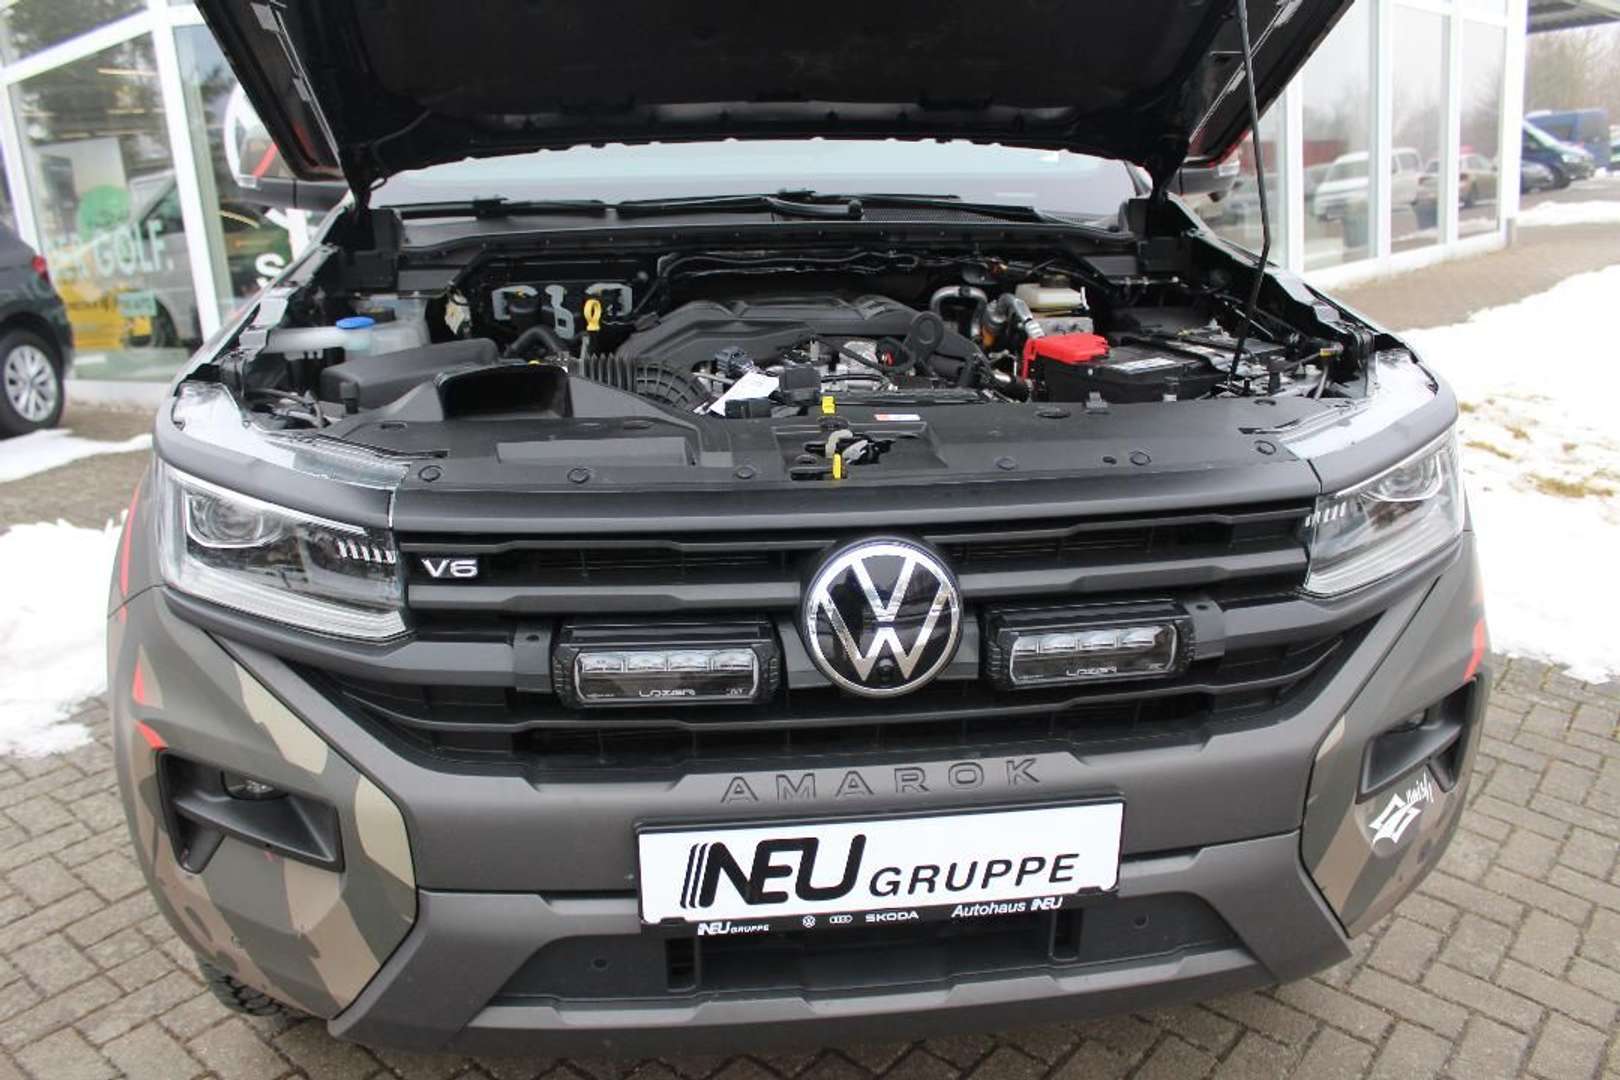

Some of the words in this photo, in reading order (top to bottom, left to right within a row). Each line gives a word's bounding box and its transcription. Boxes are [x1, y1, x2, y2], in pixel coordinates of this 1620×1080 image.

[421, 558, 478, 577] V6
[720, 757, 1041, 804] AMAROK
[680, 834, 867, 909] NEU
[868, 853, 1079, 898] GRUPPE
[951, 902, 1026, 918] Autohaus
